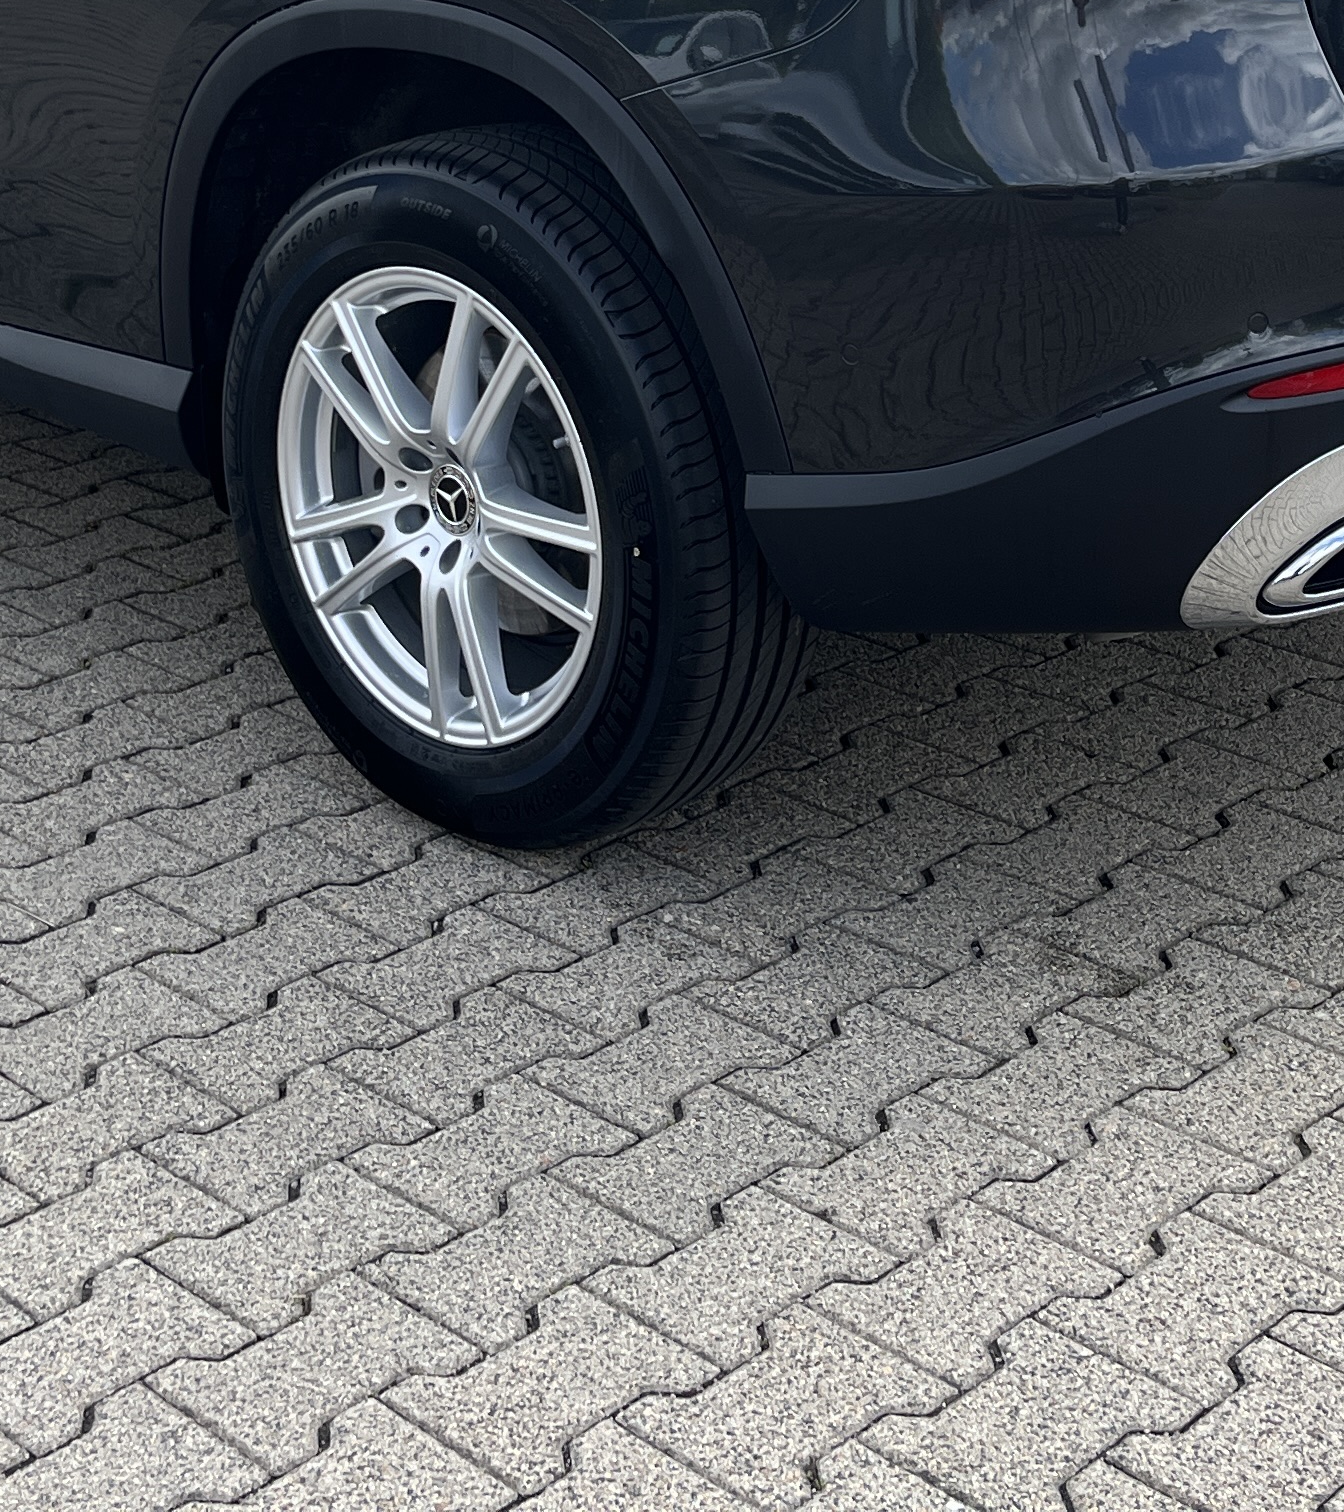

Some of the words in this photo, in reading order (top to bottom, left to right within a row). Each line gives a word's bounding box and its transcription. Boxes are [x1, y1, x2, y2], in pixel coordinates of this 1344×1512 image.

[327, 208, 338, 228] R
[343, 200, 360, 222] 18
[400, 196, 454, 221] OUTSIDE
[498, 238, 543, 283] MICHELIN
[591, 555, 654, 763] MICHELIN
